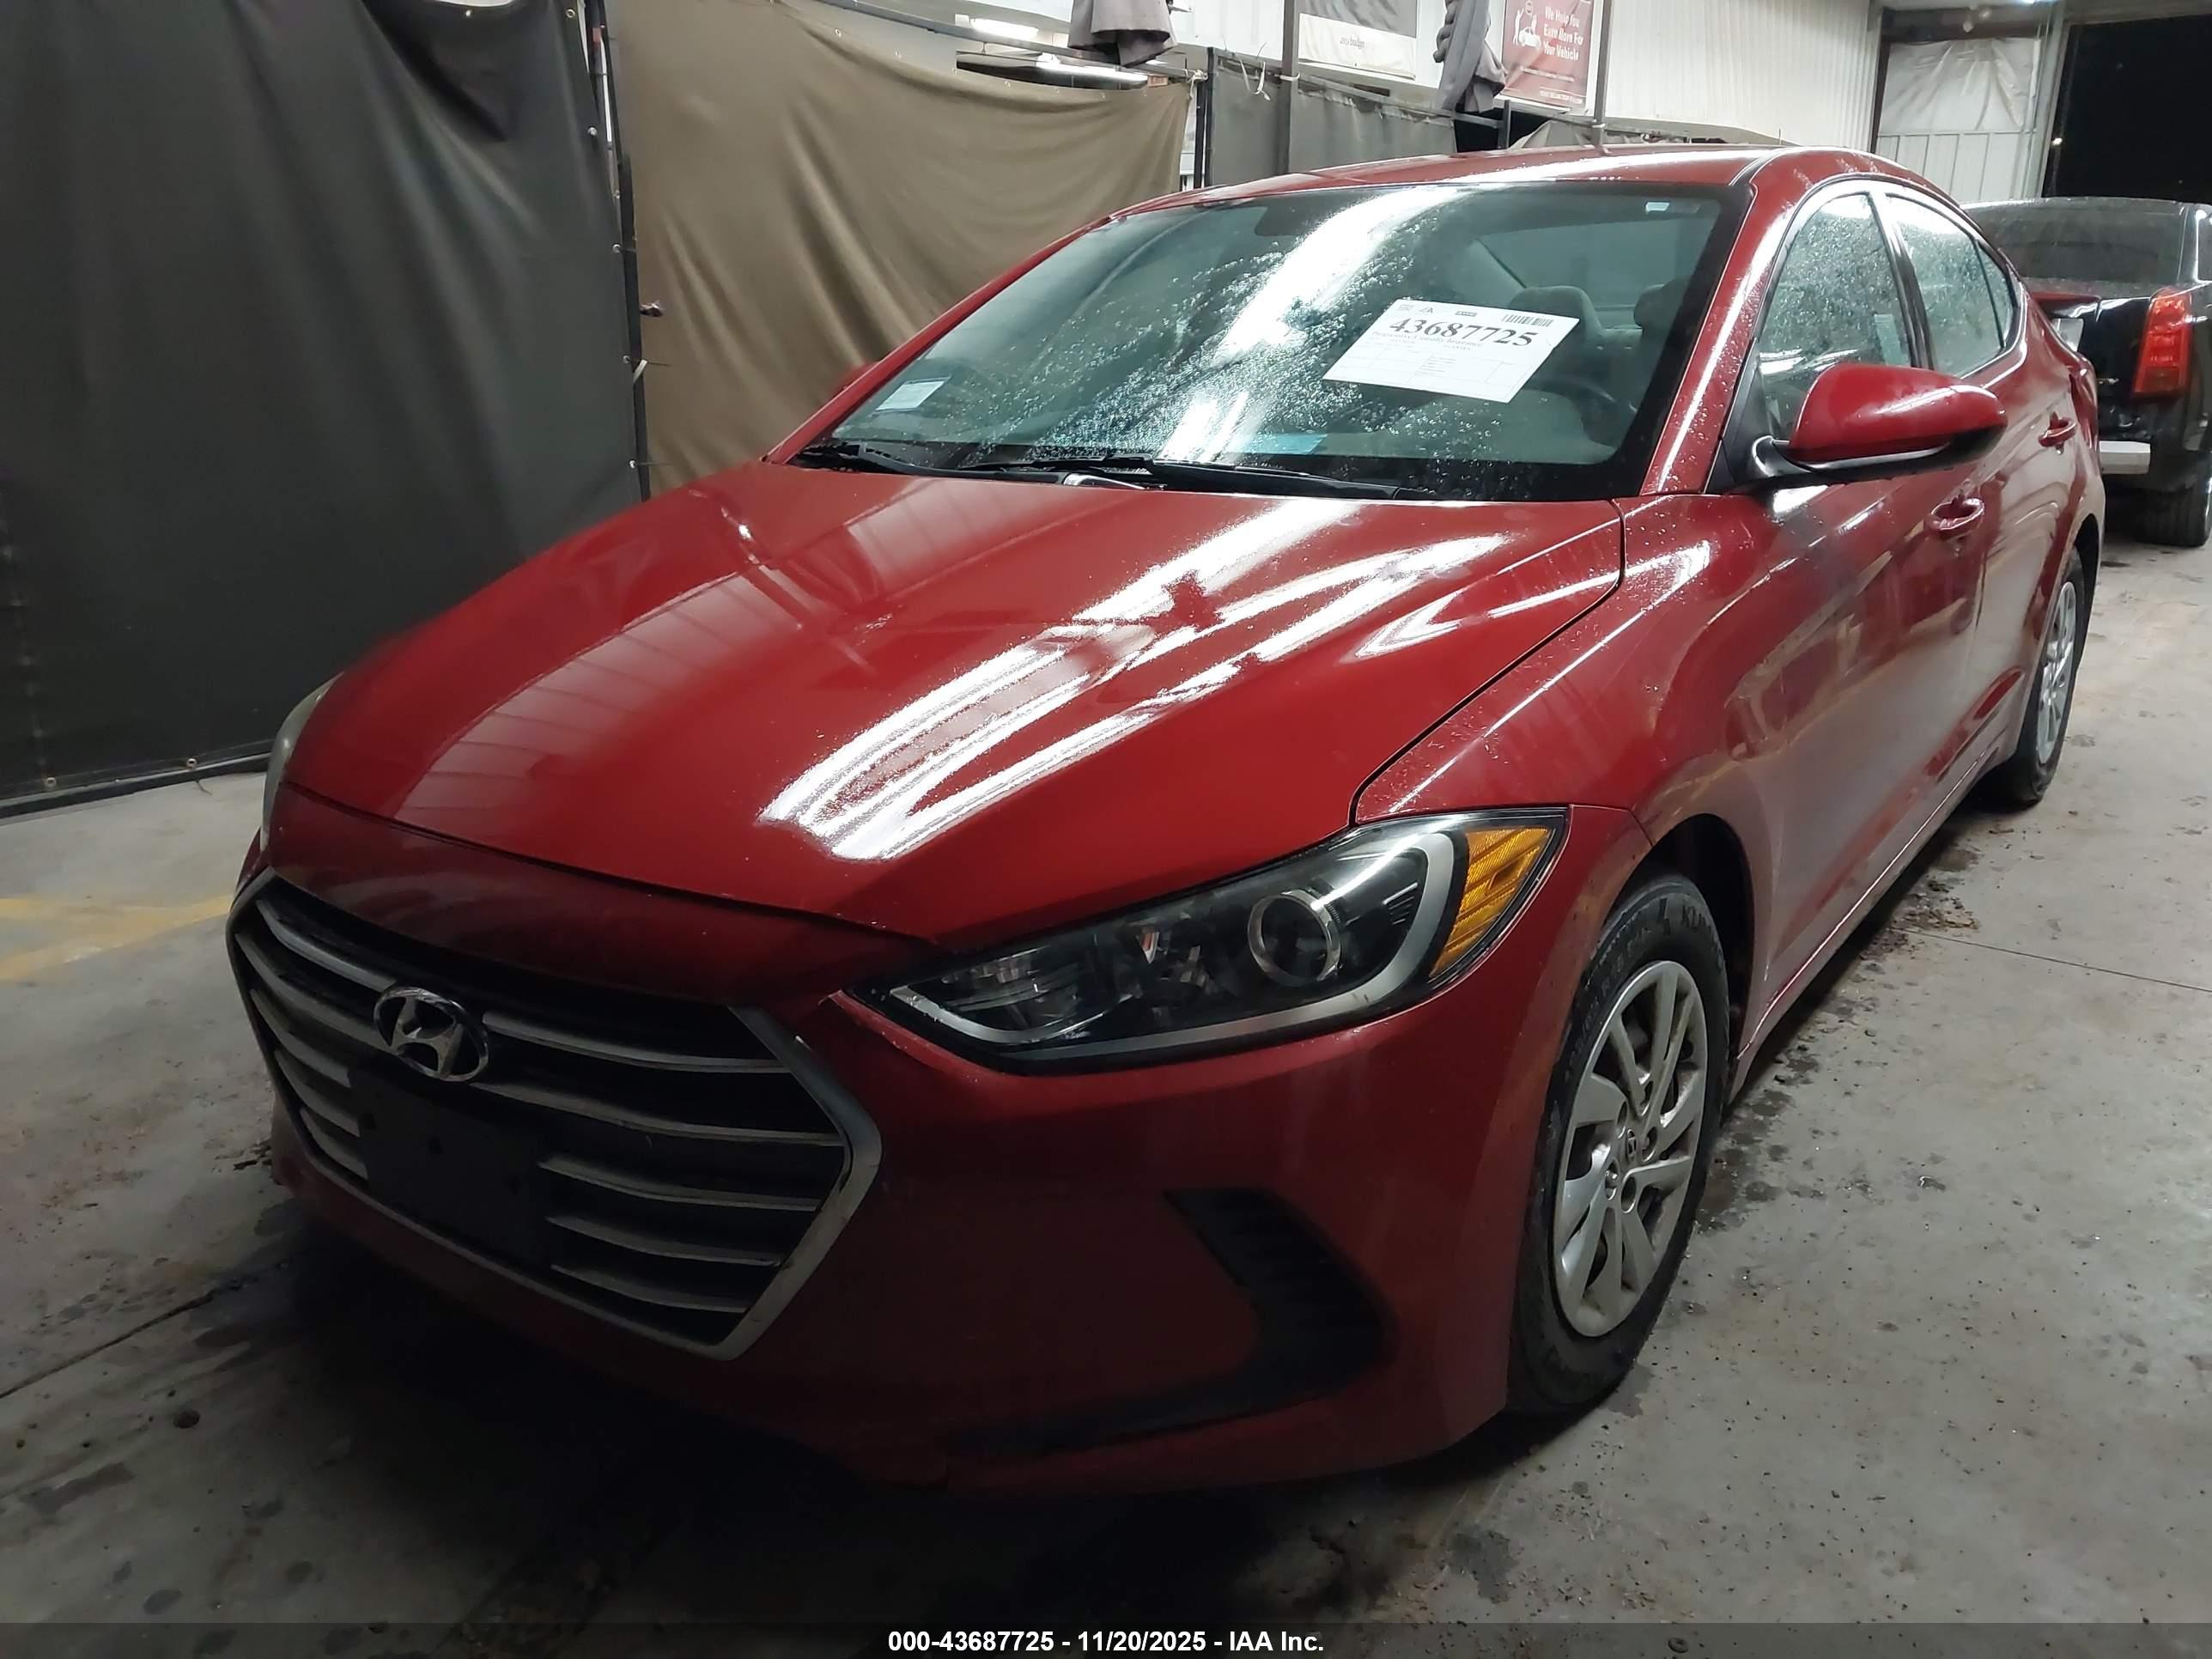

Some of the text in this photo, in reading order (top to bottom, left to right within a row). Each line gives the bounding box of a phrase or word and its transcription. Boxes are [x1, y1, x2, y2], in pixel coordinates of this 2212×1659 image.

[1544, 24, 1558, 38] Earn
[1558, 27, 1573, 43] More
[1543, 40, 1579, 61] Your Vehicle
[1389, 318, 1539, 347] 43687725
